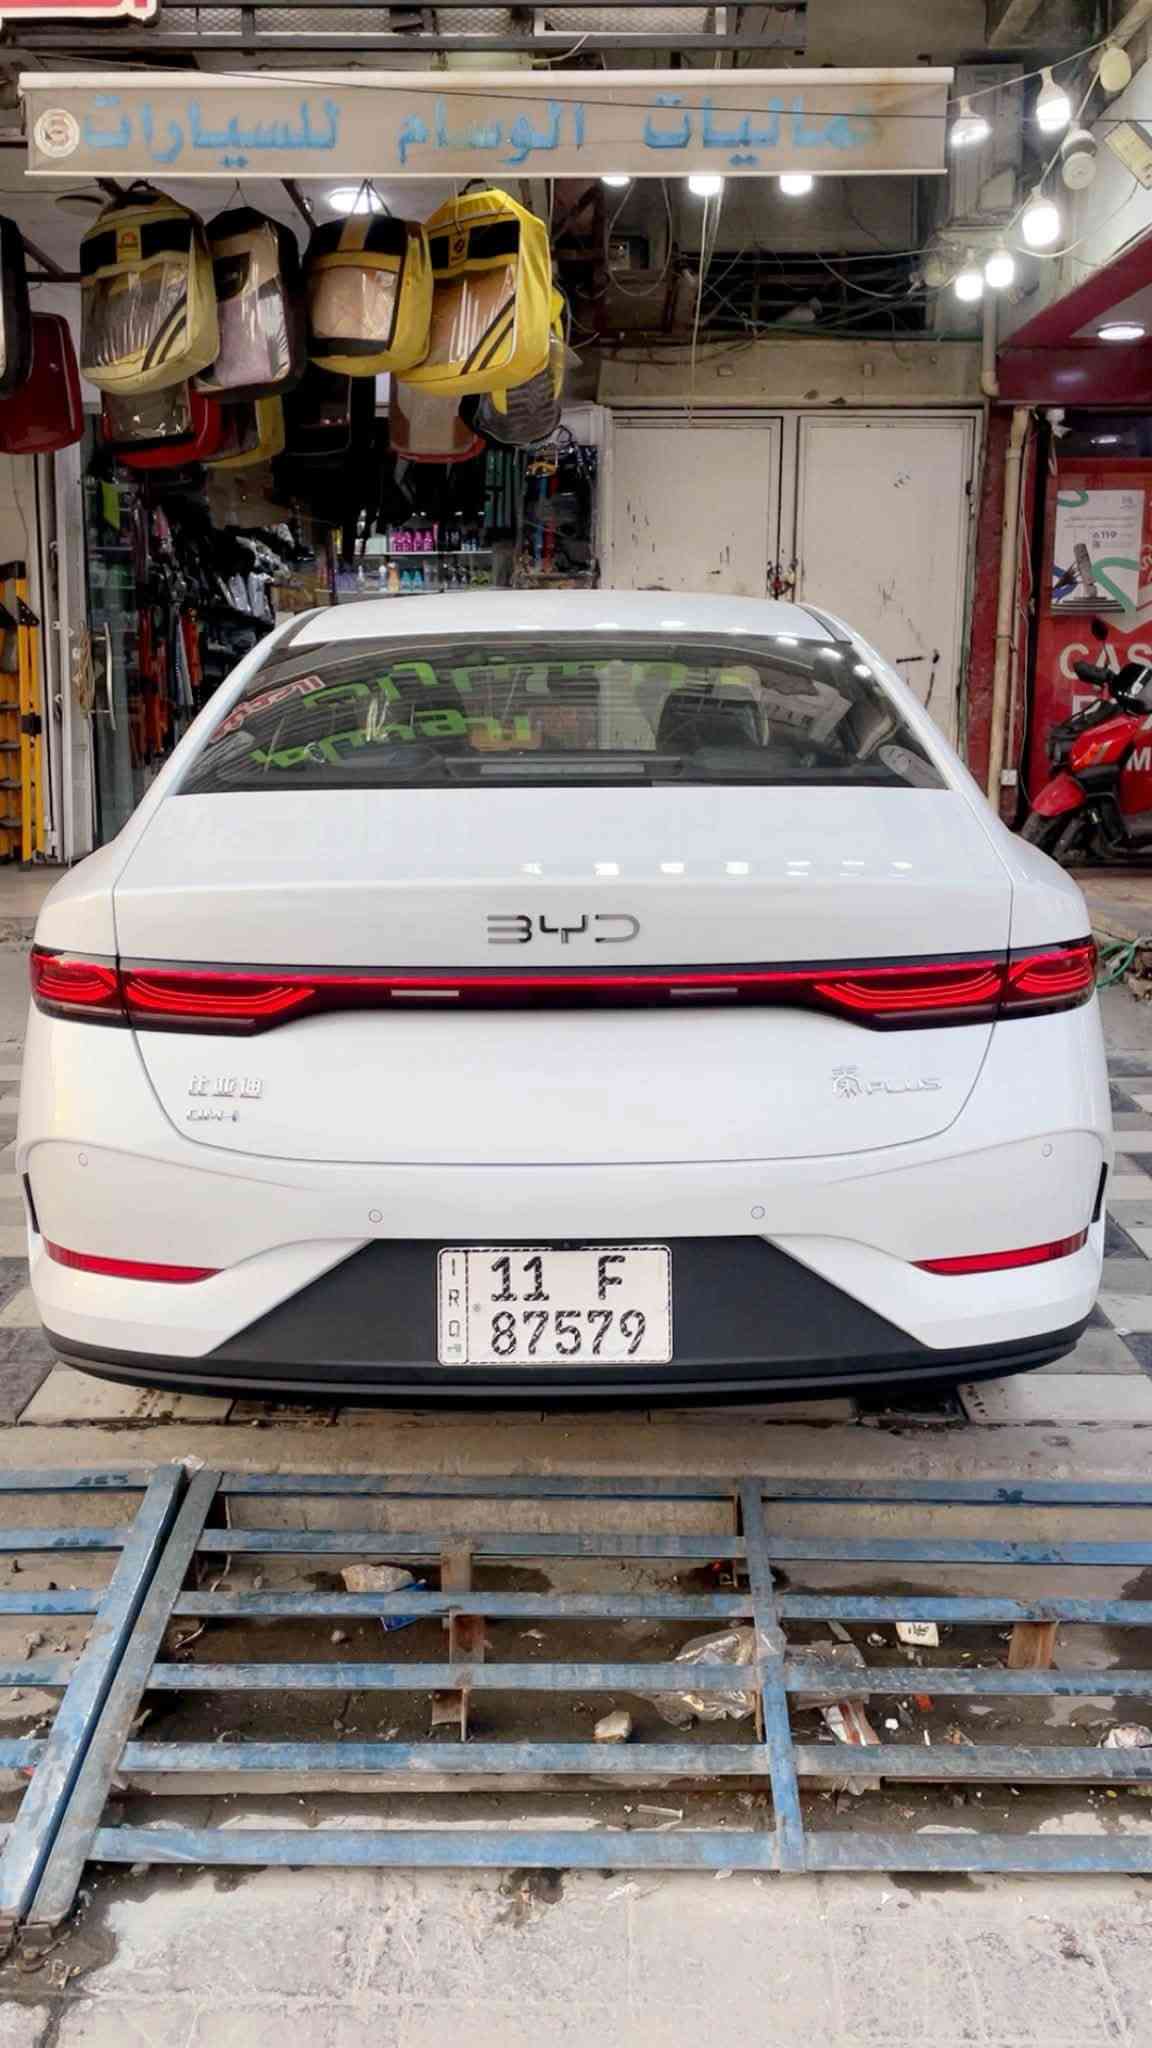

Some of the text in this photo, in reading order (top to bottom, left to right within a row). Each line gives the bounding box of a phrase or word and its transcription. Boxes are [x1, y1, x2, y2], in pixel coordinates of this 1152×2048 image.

[85, 95, 338, 164] للسيارات
[398, 95, 584, 165] الوسام
[488, 914, 640, 944] BYD
[491, 1255, 626, 1301] 11 F
[491, 1310, 646, 1355] 87579
